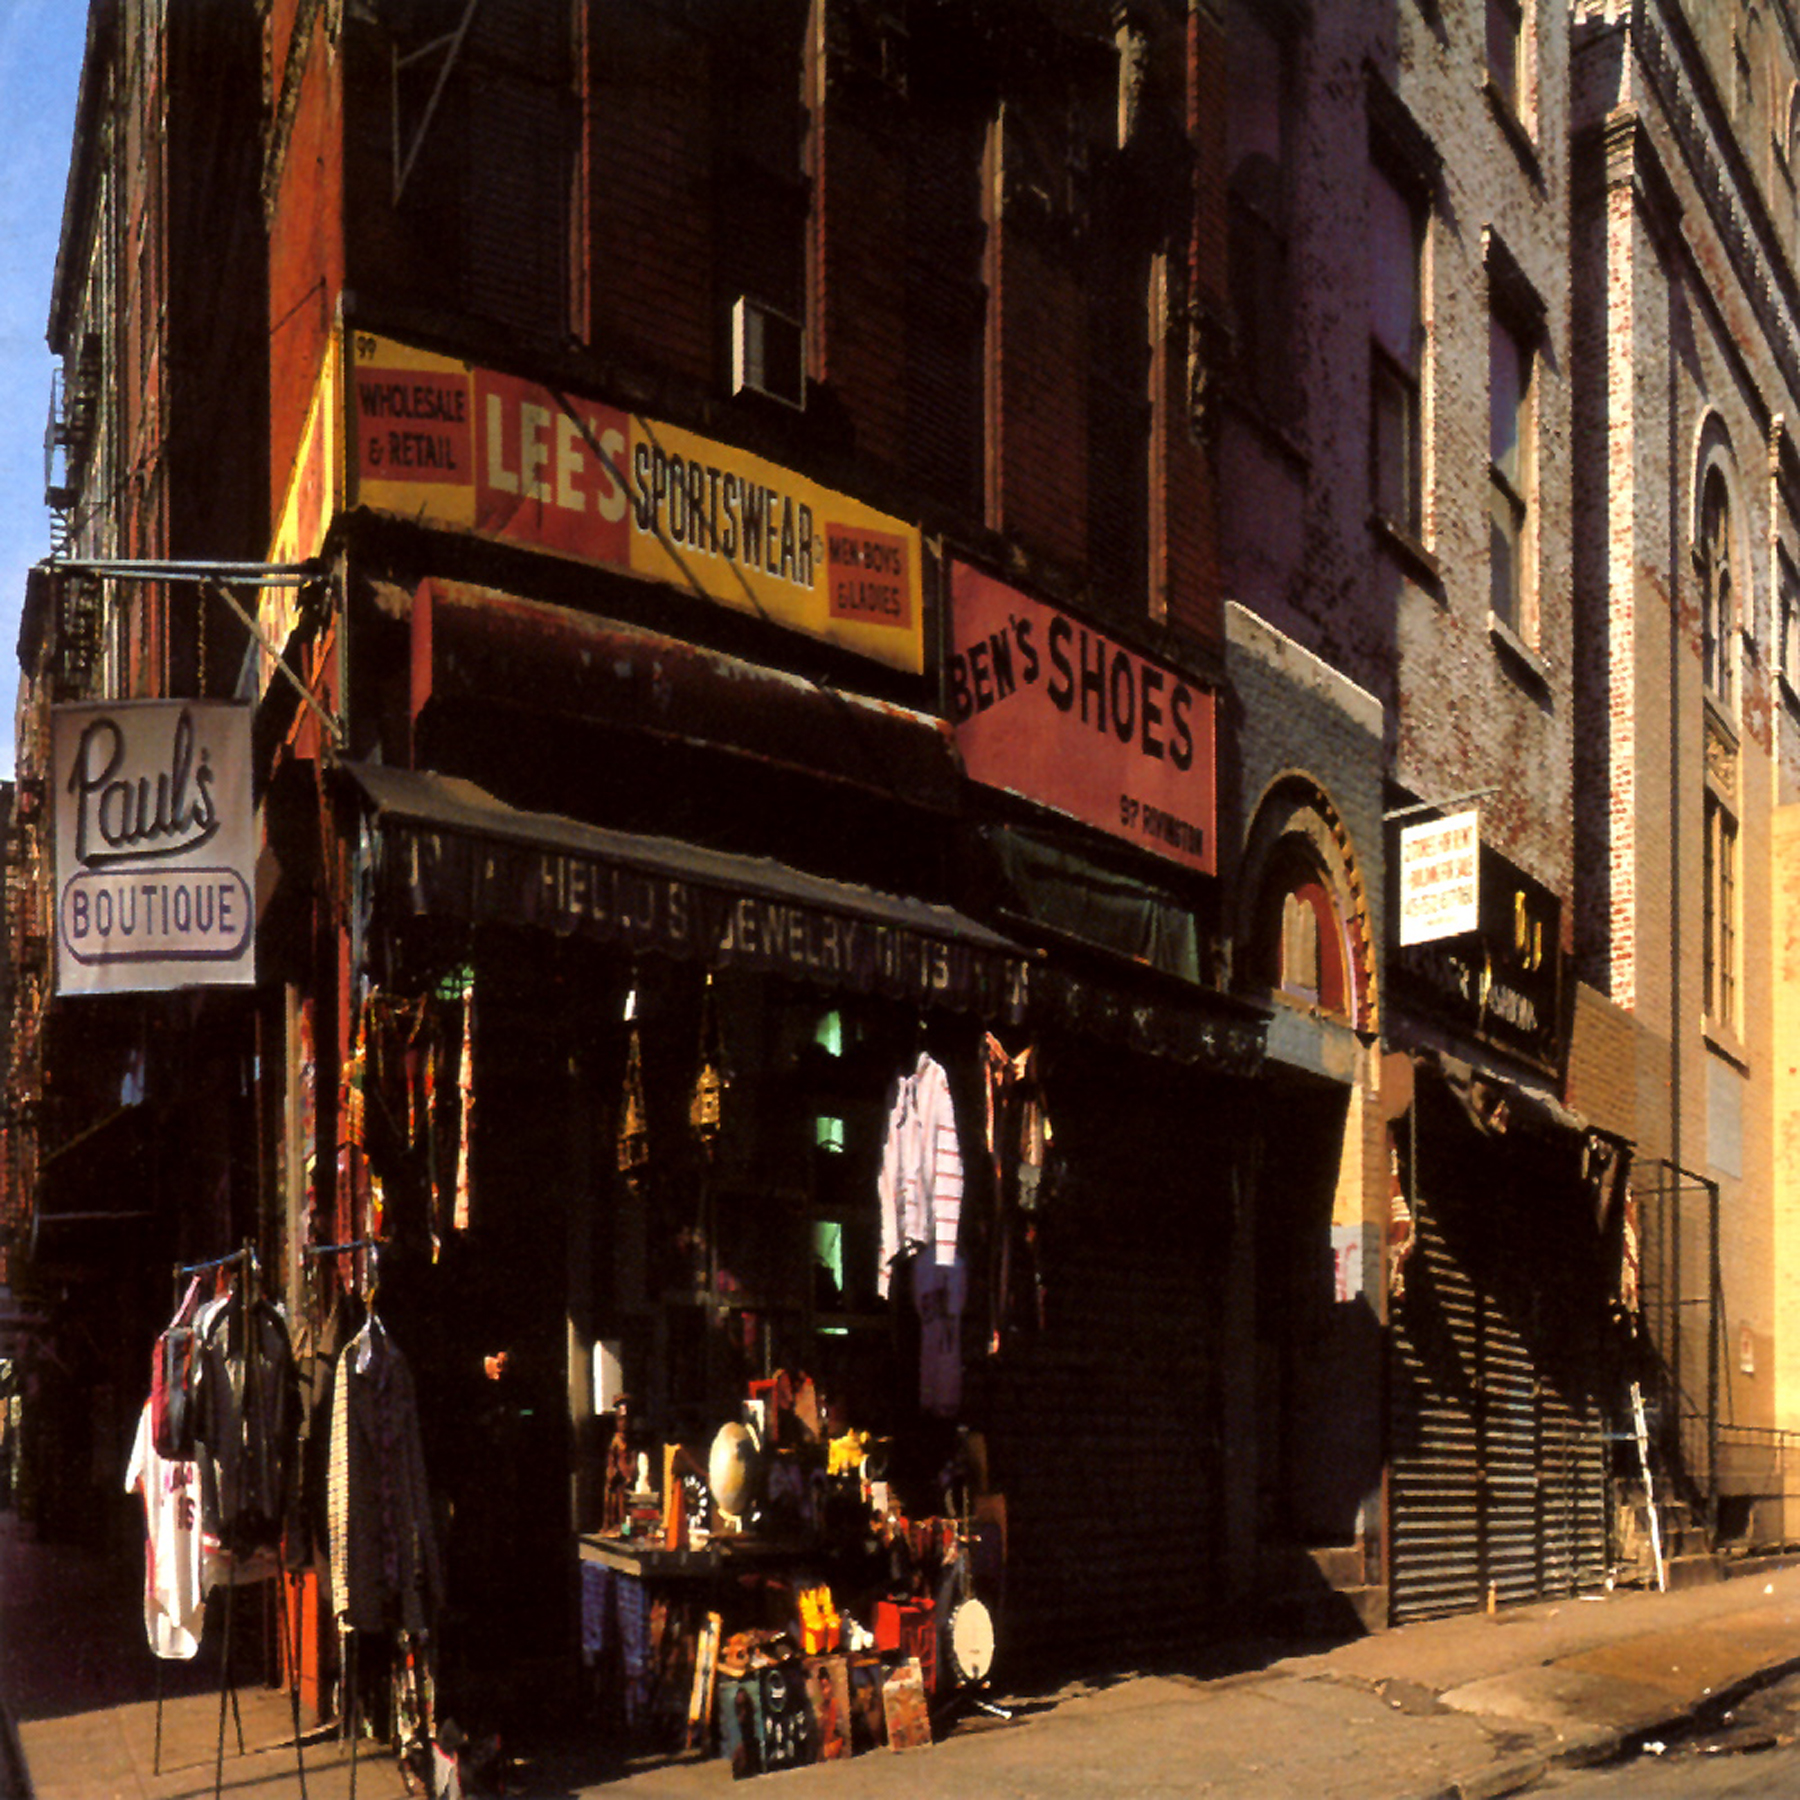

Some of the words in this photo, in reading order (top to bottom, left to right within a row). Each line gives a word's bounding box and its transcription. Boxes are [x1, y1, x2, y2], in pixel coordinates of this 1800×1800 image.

[356, 336, 377, 360] 99
[359, 383, 466, 423] WHOLESALE
[368, 437, 384, 466] &
[387, 430, 456, 471] RETAIL
[486, 393, 627, 523] LEE'S
[633, 442, 815, 591] SPORTSWEAR
[950, 613, 1040, 728] BEN'S
[1047, 615, 1194, 772] SHOES
[67, 706, 221, 869] Paul's
[72, 884, 237, 938] BOUTIQUE
